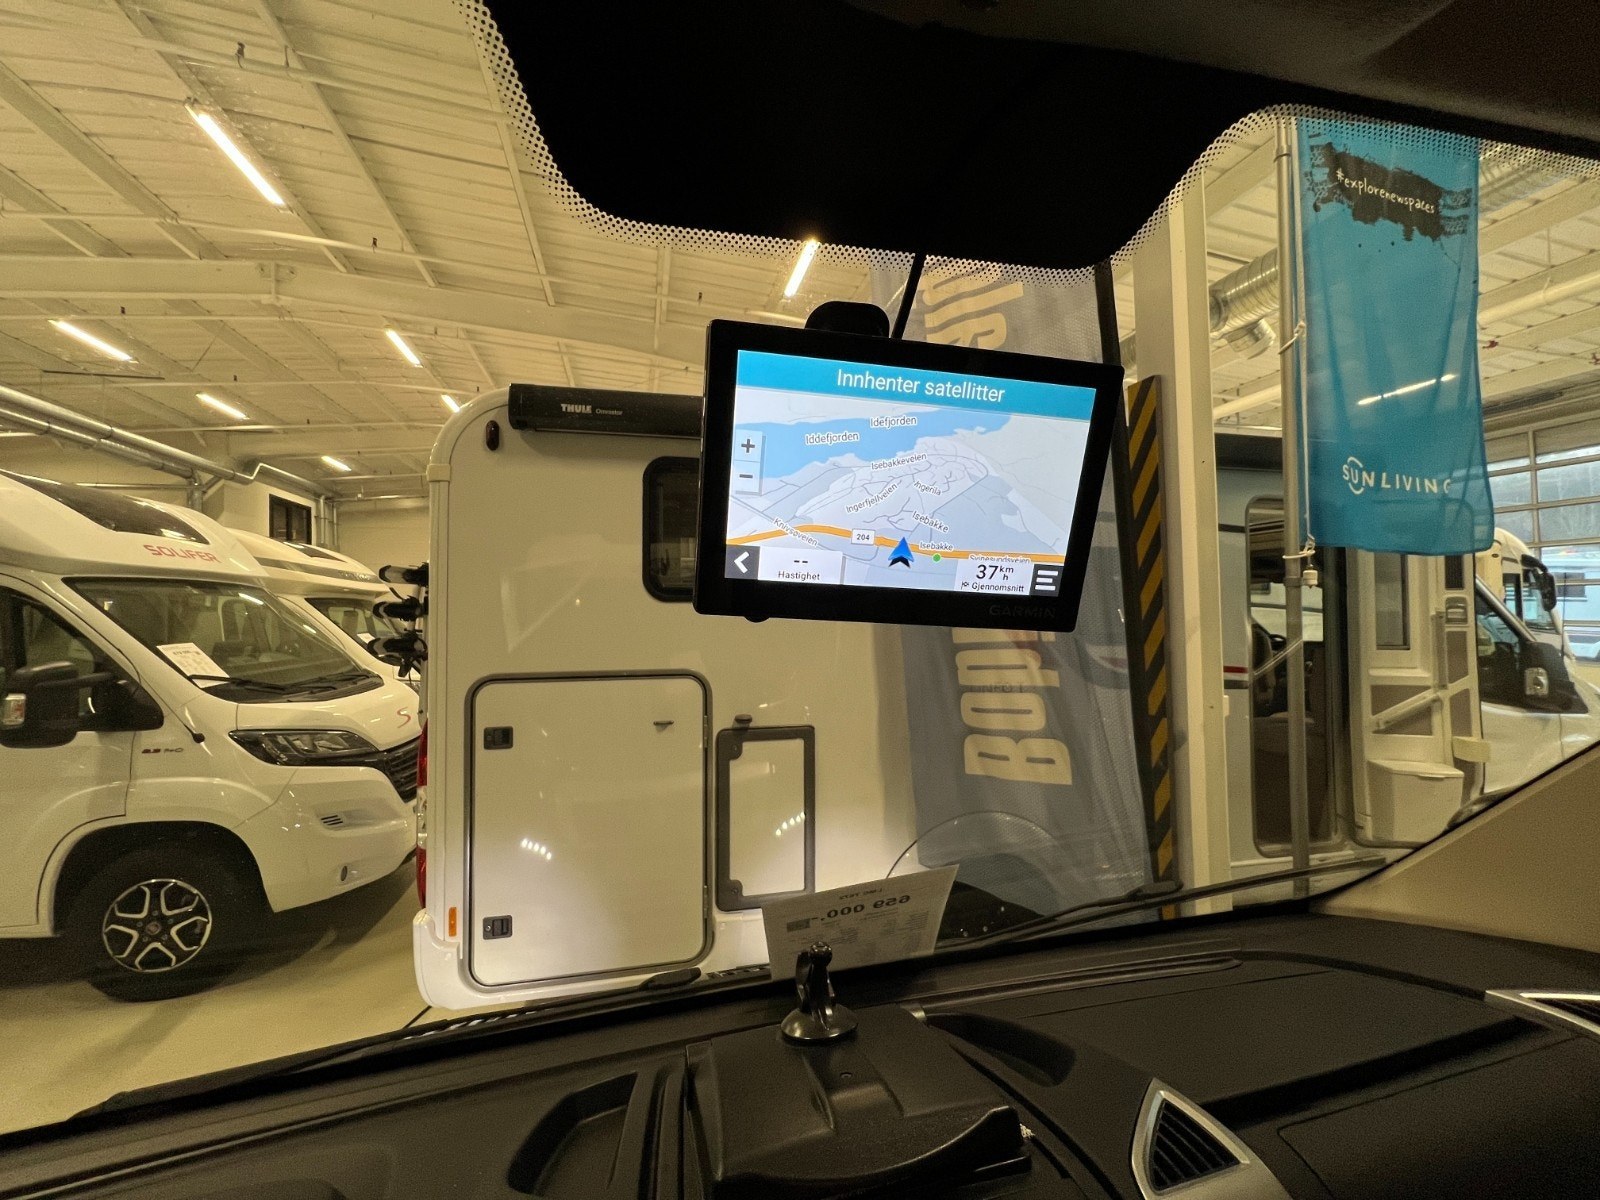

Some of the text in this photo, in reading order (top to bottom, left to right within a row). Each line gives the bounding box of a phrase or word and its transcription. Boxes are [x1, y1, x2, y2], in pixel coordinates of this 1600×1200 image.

[1336, 168, 1435, 214] #explorenewspaces
[837, 369, 1005, 403] Innhenter satellitter
[560, 403, 592, 414] THULE
[870, 415, 917, 428] Idefjorden
[805, 431, 859, 445] Iddefjorden
[871, 453, 927, 470] Isebakkeveien
[846, 483, 898, 514] Ingerfjellveien
[912, 510, 949, 533] Isebakke
[773, 518, 818, 546] Knivsøveien
[856, 533, 870, 541] 204
[919, 541, 954, 551] Isebakke
[143, 544, 222, 564] SOLIFER
[778, 570, 820, 581] Hastighet
[976, 564, 1014, 580] 37 km
[1002, 573, 1009, 581] h
[971, 581, 1024, 593] Gjennomsnitt
[989, 604, 1056, 618] GARMIN
